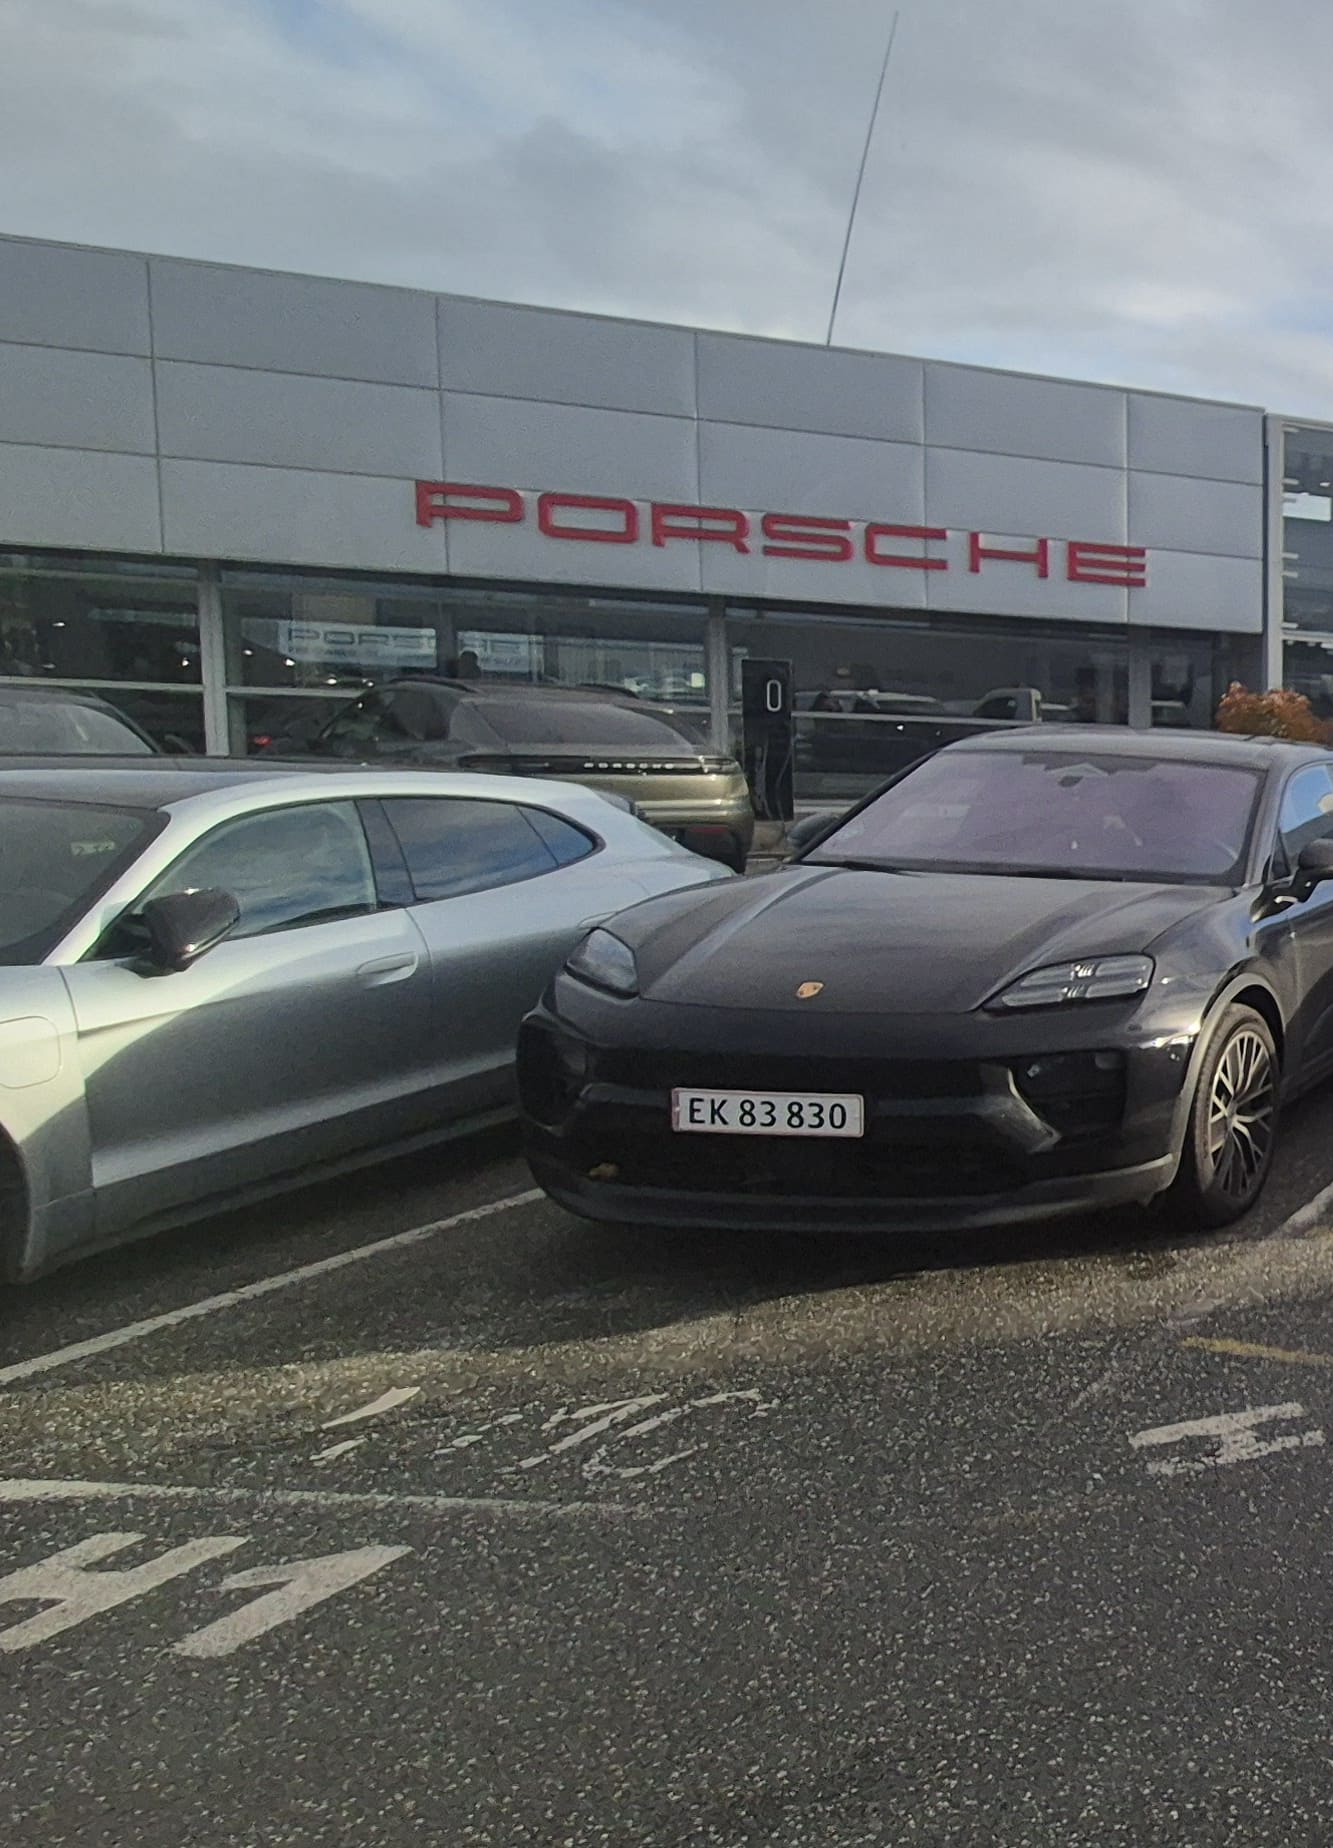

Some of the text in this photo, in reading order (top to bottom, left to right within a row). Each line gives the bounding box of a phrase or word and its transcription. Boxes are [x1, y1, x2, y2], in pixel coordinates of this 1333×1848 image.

[415, 479, 1147, 587] PORSCHE
[688, 1098, 847, 1129] EK 83 830
